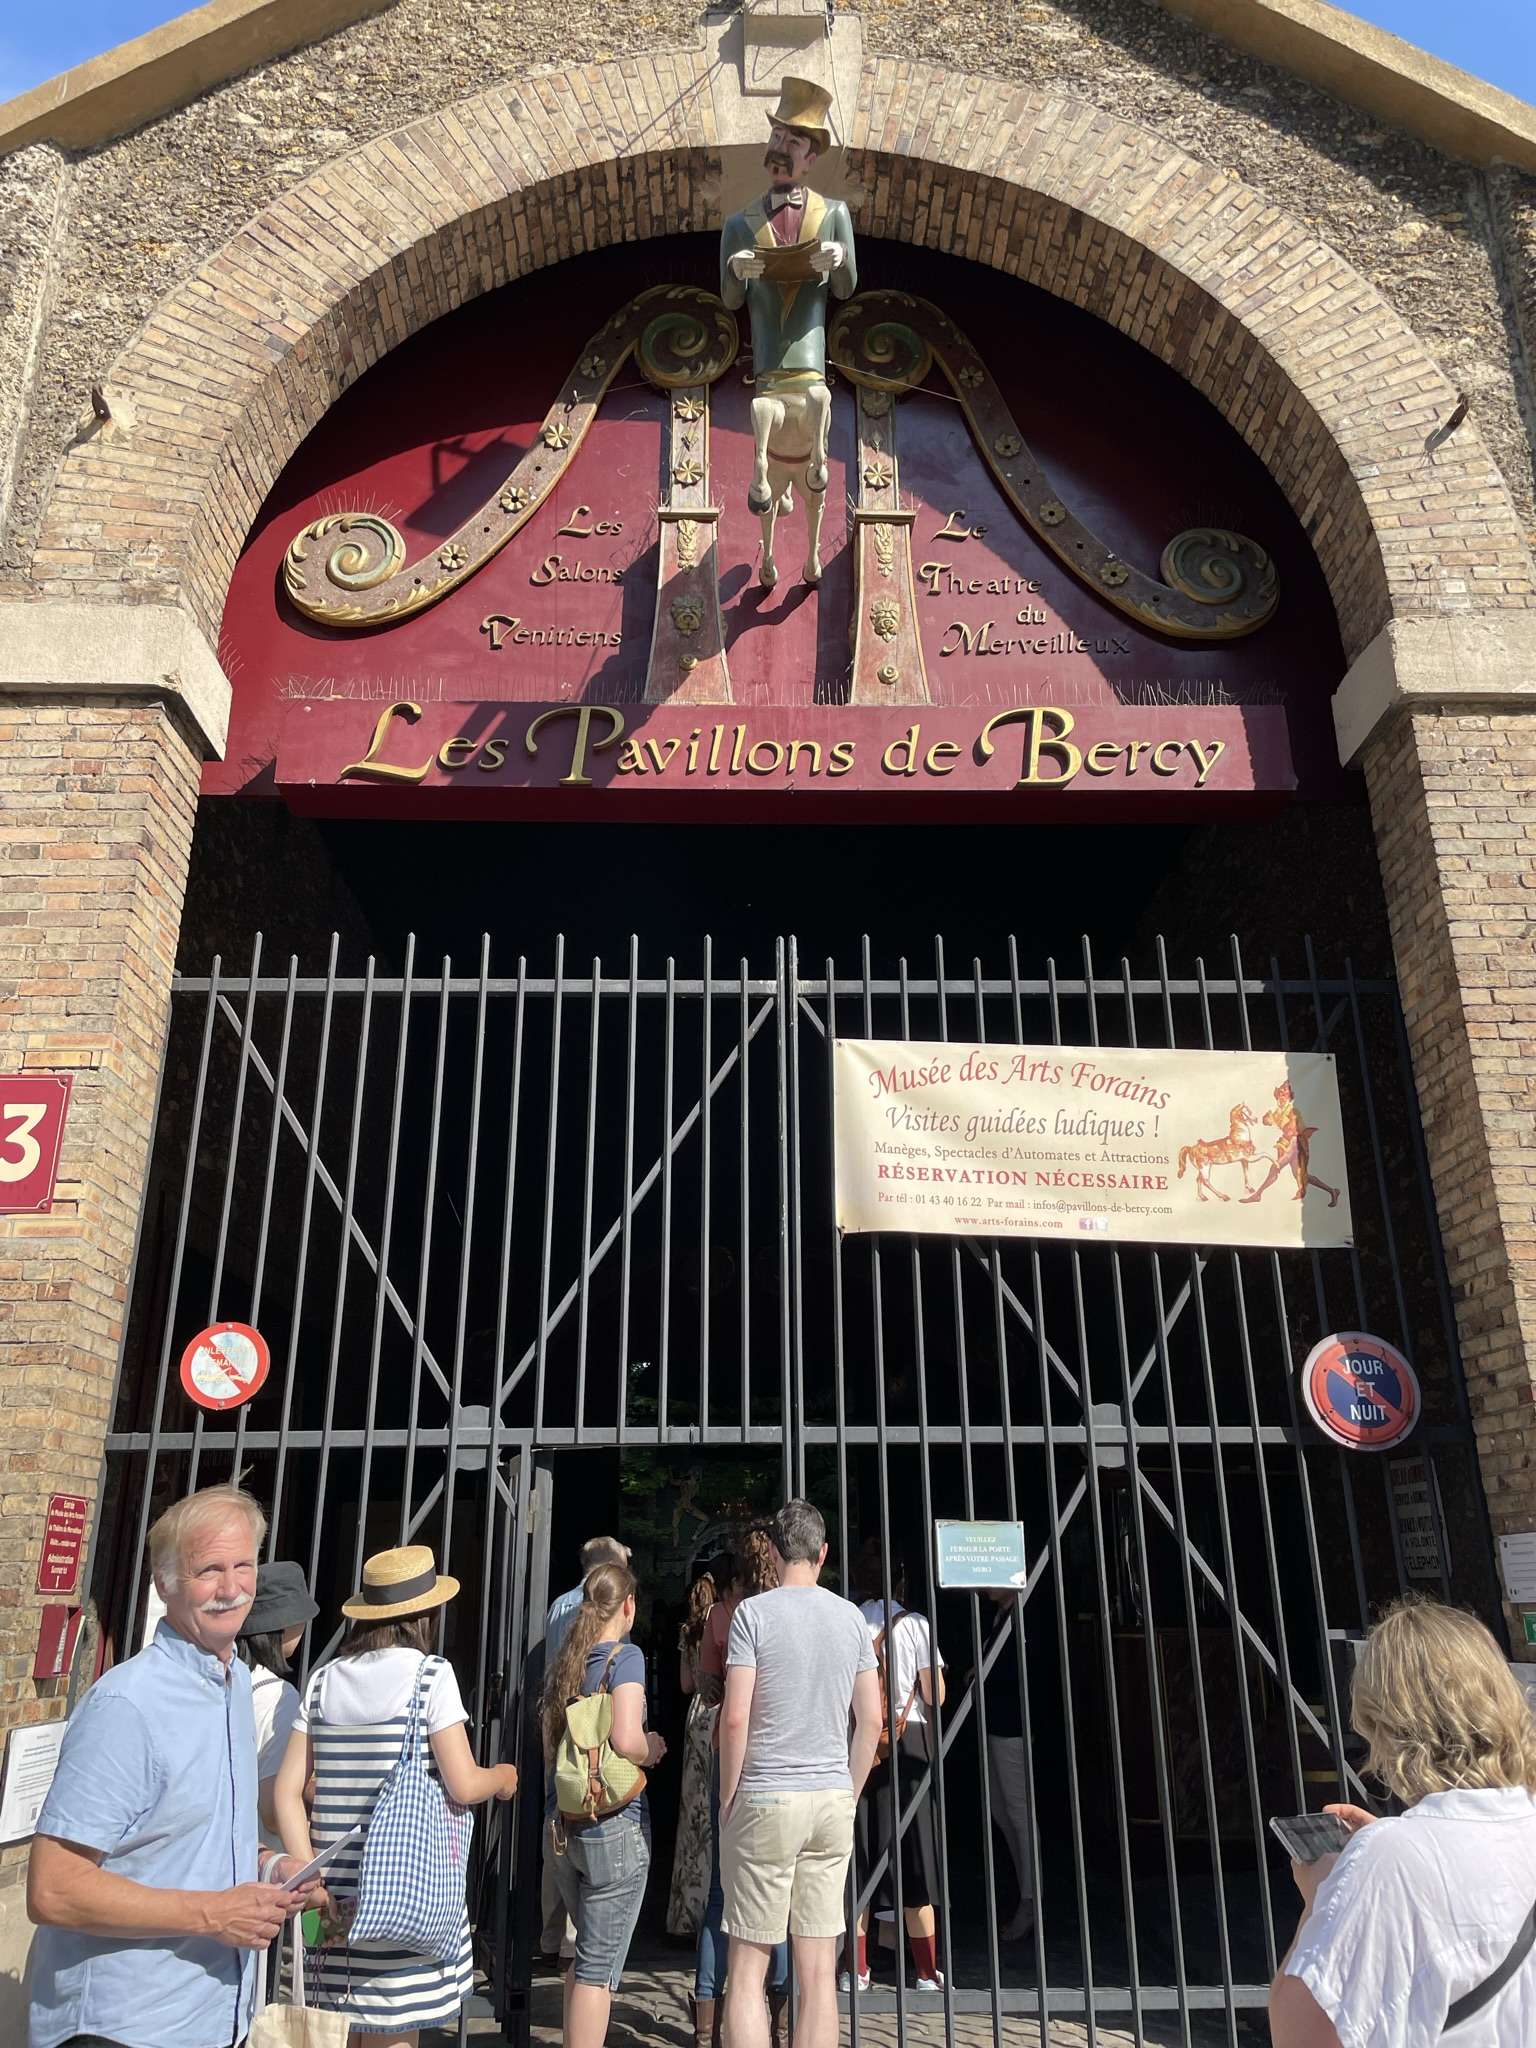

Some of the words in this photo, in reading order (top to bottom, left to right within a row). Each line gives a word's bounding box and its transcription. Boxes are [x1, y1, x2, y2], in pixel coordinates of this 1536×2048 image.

[558, 505, 624, 538] Les
[932, 510, 987, 542] Le
[529, 554, 625, 586] Salons
[918, 562, 1041, 595] Theatre
[1017, 603, 1047, 625] du
[941, 621, 1130, 656] Merveilleux
[340, 701, 510, 784] Les
[526, 705, 856, 785] Pavillons
[881, 724, 962, 776] de
[973, 706, 1226, 788] Bercy
[869, 1056, 952, 1098] Musée
[959, 1050, 1000, 1082] des
[1001, 1054, 1064, 1085] Arts
[1071, 1062, 1171, 1110] Forains
[886, 1104, 961, 1132] Visites
[964, 1107, 1047, 1142] guidées
[1054, 1108, 1146, 1146] ludiques
[1153, 1114, 1160, 1138] !
[0, 1103, 48, 1182] 3
[874, 1141, 931, 1159] Manèges,
[934, 1145, 998, 1161] Spectacles
[1084, 1152, 1097, 1162] et
[1100, 1150, 1170, 1165] Attractions
[877, 1162, 1028, 1186] RÉSERVATION
[1034, 1168, 1169, 1190] NÉCESSAIRE
[878, 1191, 894, 1203] Par
[915, 1194, 926, 1204] 01
[929, 1194, 941, 1205] 43
[943, 1195, 955, 1206] 40
[957, 1196, 969, 1207] 16
[970, 1197, 982, 1208] 22
[985, 1197, 1004, 1208] Par
[1005, 1198, 1025, 1209] mail
[1033, 1199, 1173, 1217] infos@pavillons-de-bercy.com
[954, 1216, 1063, 1230] www.arts-forains.com
[1342, 1359, 1384, 1375] JOUR
[1356, 1381, 1376, 1398] ET
[1350, 1404, 1386, 1421] NUIT
